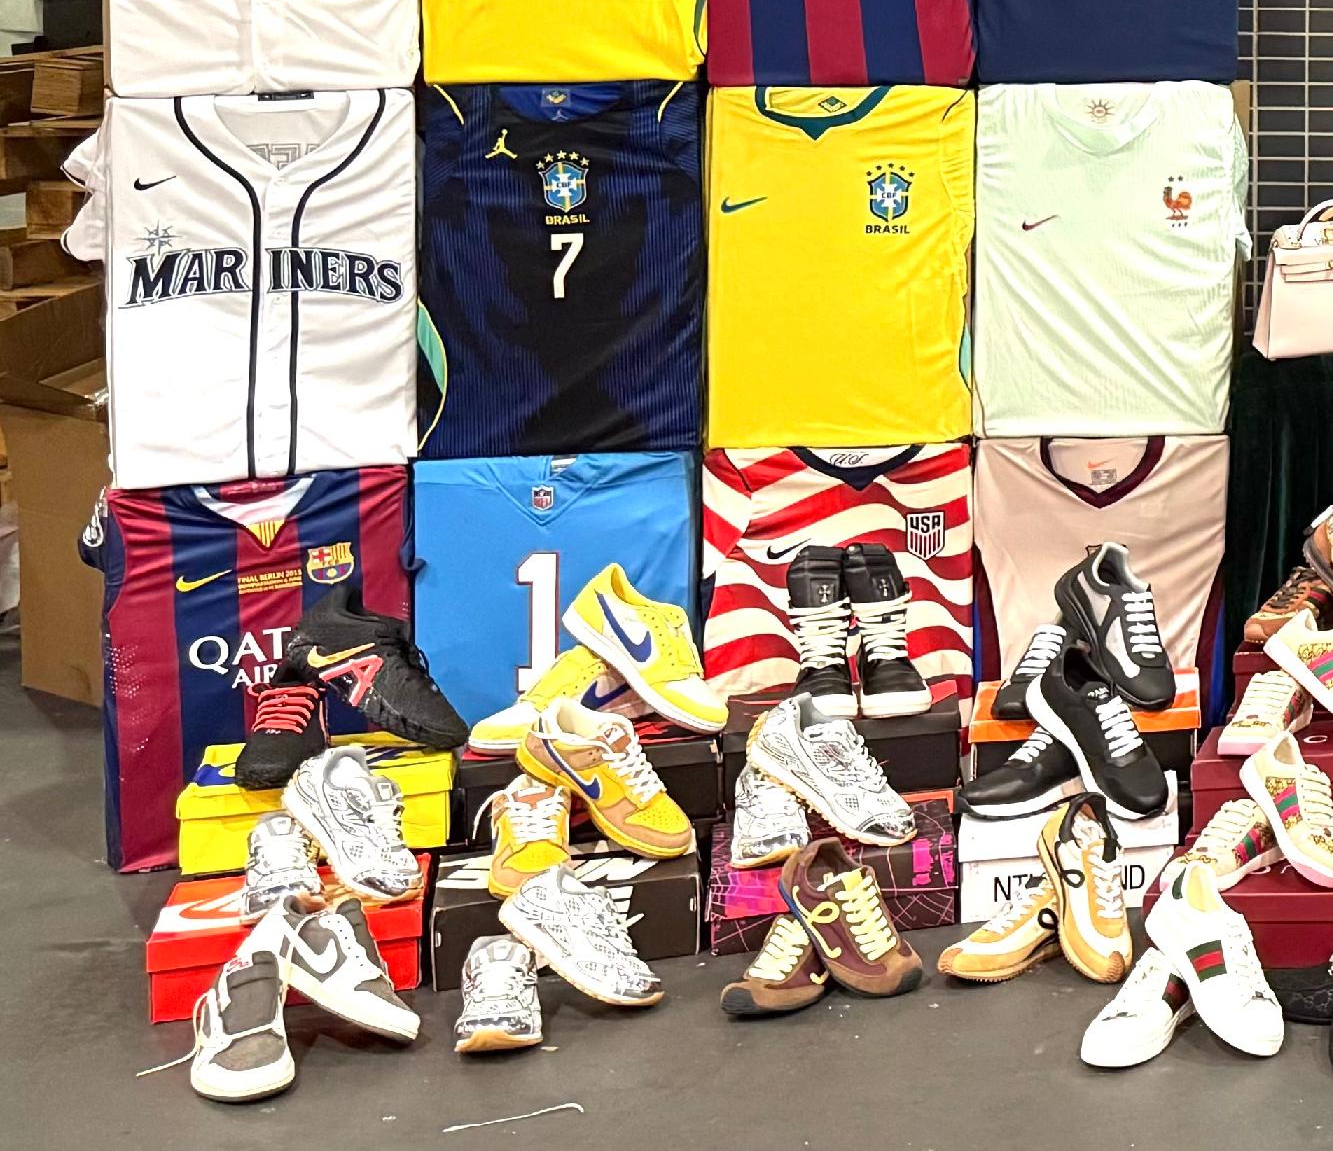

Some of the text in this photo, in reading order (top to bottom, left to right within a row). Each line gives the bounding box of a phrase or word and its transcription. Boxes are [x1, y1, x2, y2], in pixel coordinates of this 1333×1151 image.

[545, 213, 590, 225] BRASIL
[865, 224, 910, 235] BRASIL
[118, 246, 405, 310] MARINERS
[550, 232, 584, 299] 7
[909, 514, 942, 530] USA
[516, 552, 560, 693] 1
[189, 626, 293, 675] QAT
